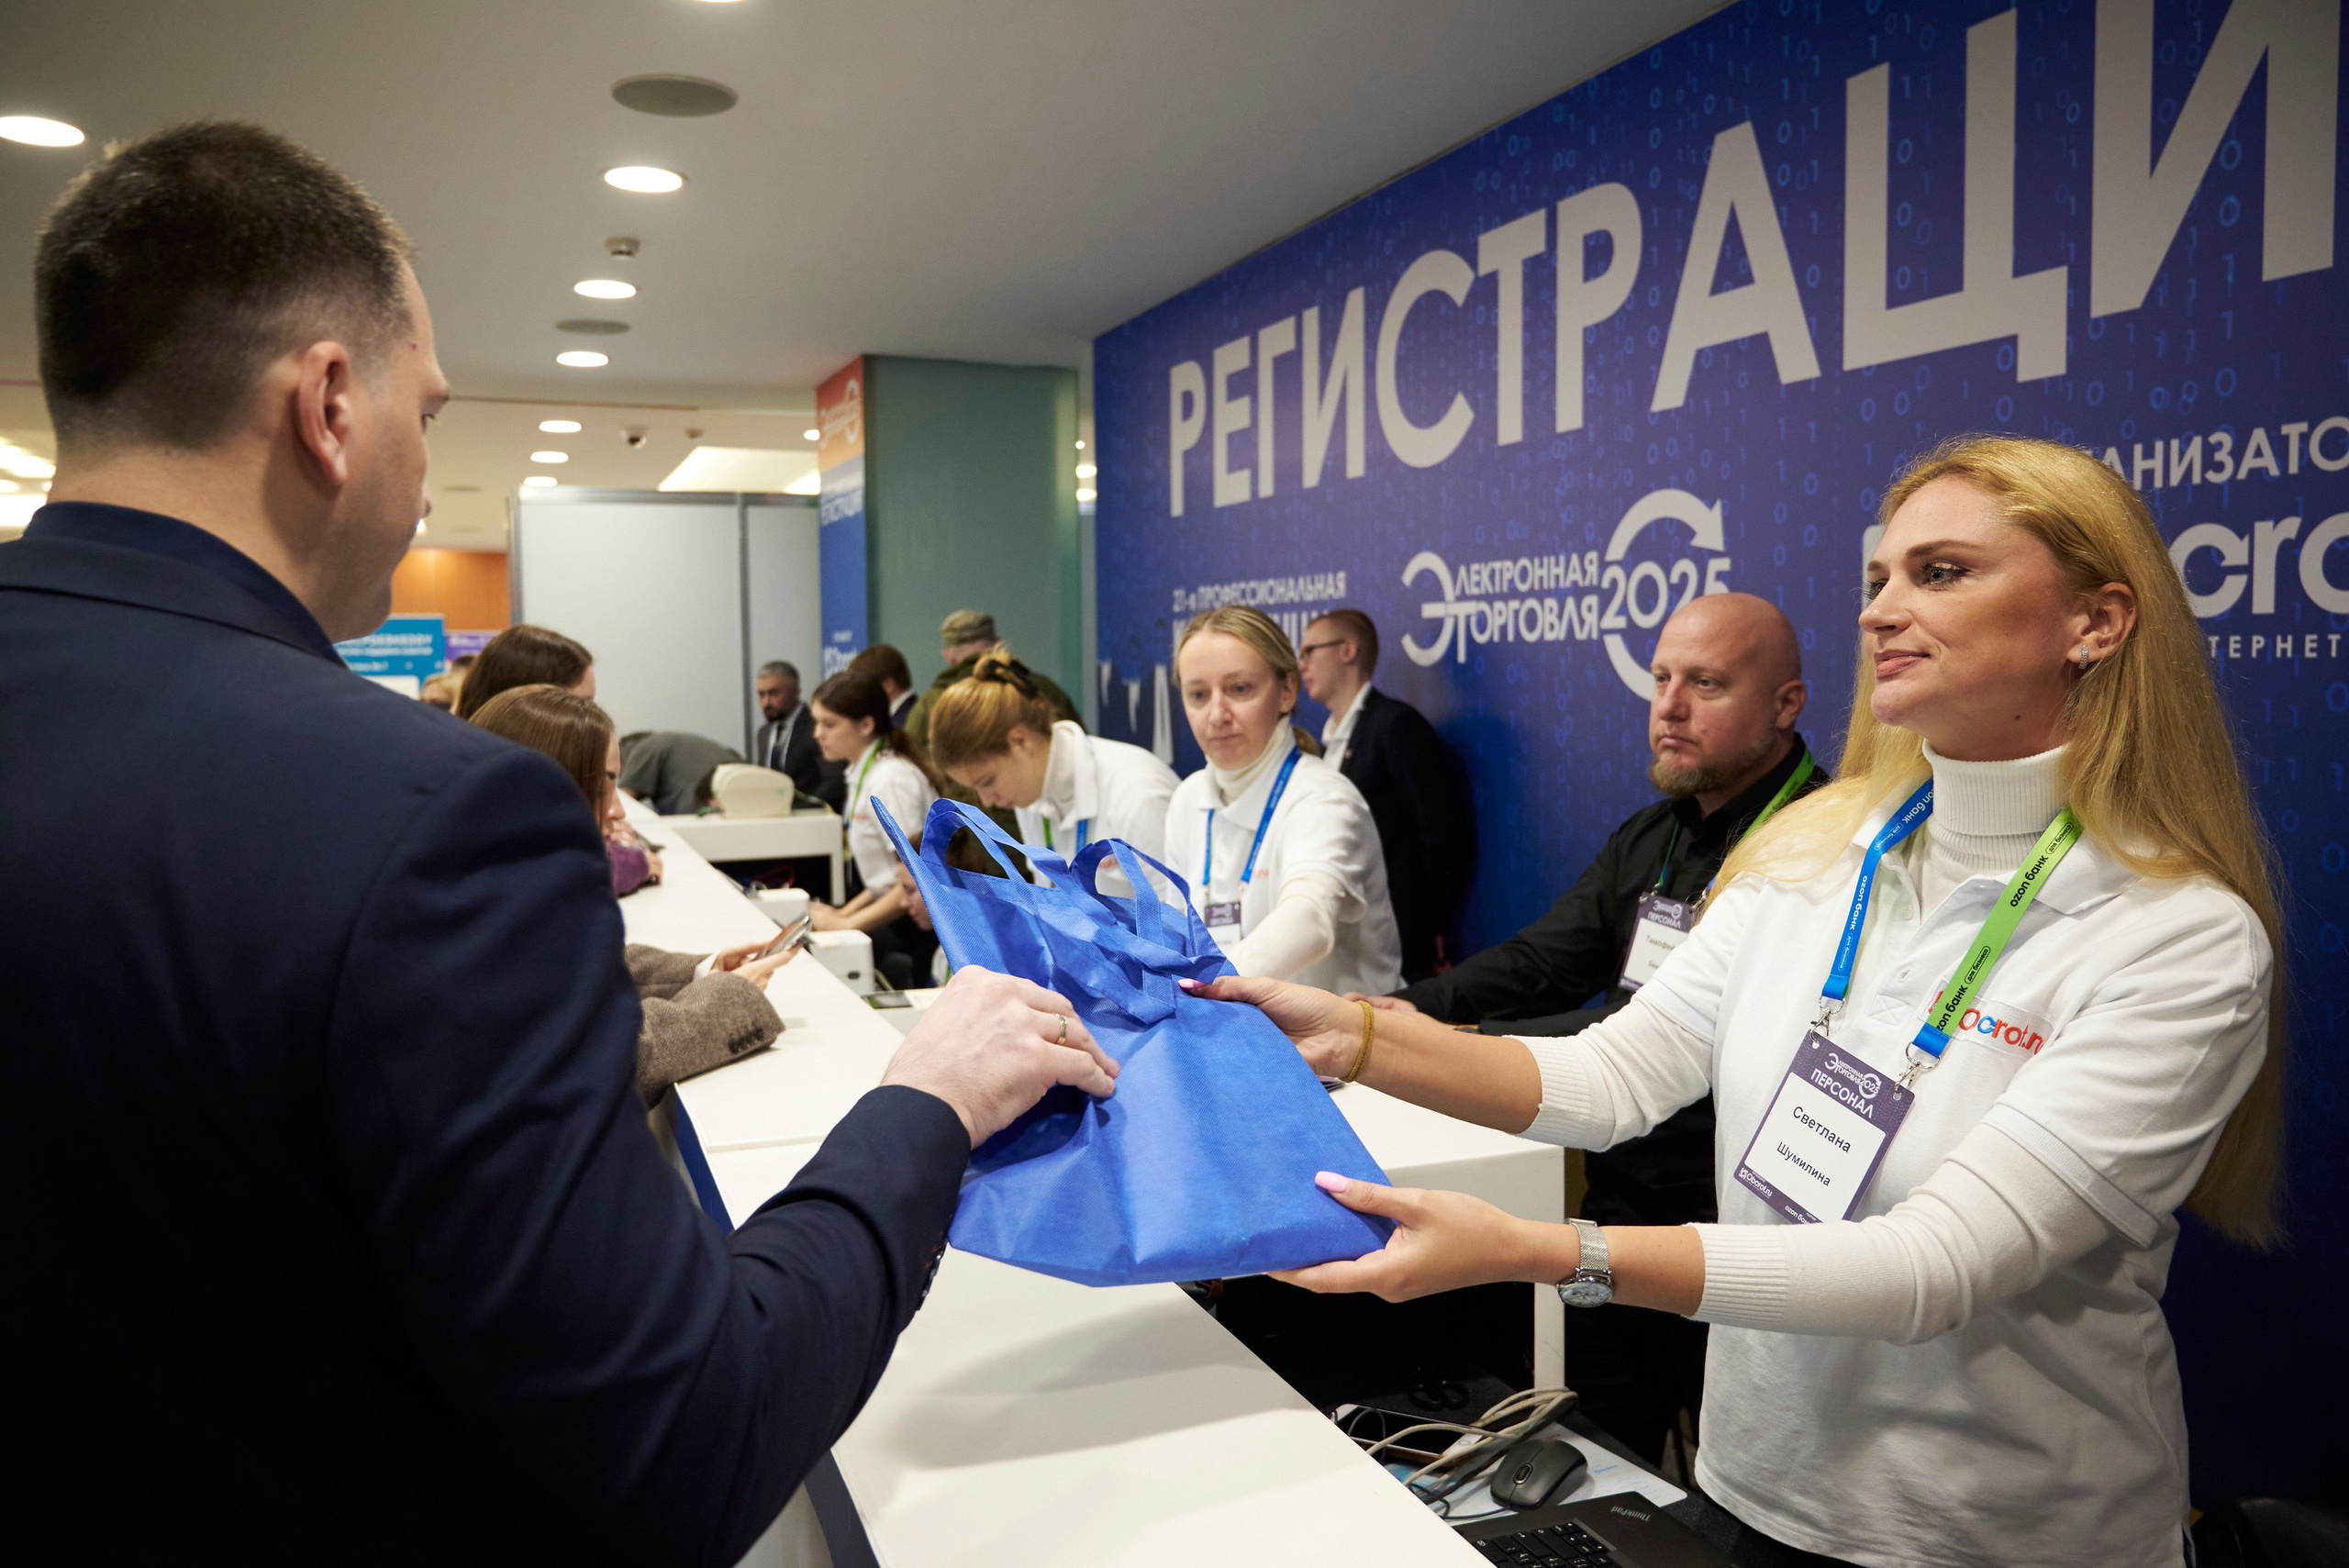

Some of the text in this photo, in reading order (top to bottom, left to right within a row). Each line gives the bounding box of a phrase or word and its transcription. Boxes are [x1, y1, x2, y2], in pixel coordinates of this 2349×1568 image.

[2081, 417, 2349, 490] АНИЗАТО
[1450, 594, 1599, 664] ТОРГОВЛЯ
[1901, 802, 1925, 823] банк
[1850, 875, 1868, 930] ozon банк
[2010, 855, 2048, 906] ozon банк
[1647, 911, 1681, 929] ПЕРСОНАЛ
[1945, 984, 1968, 1013] банк
[1810, 1068, 1874, 1119] ПЕРСОНАЛ
[1859, 1077, 1881, 1095] 2025
[1792, 1106, 1852, 1153] Светлана
[1776, 1141, 1831, 1187] Шумилина
[1785, 1205, 1798, 1218] ozon
[1610, 1506, 1651, 1521] ThinkPad
